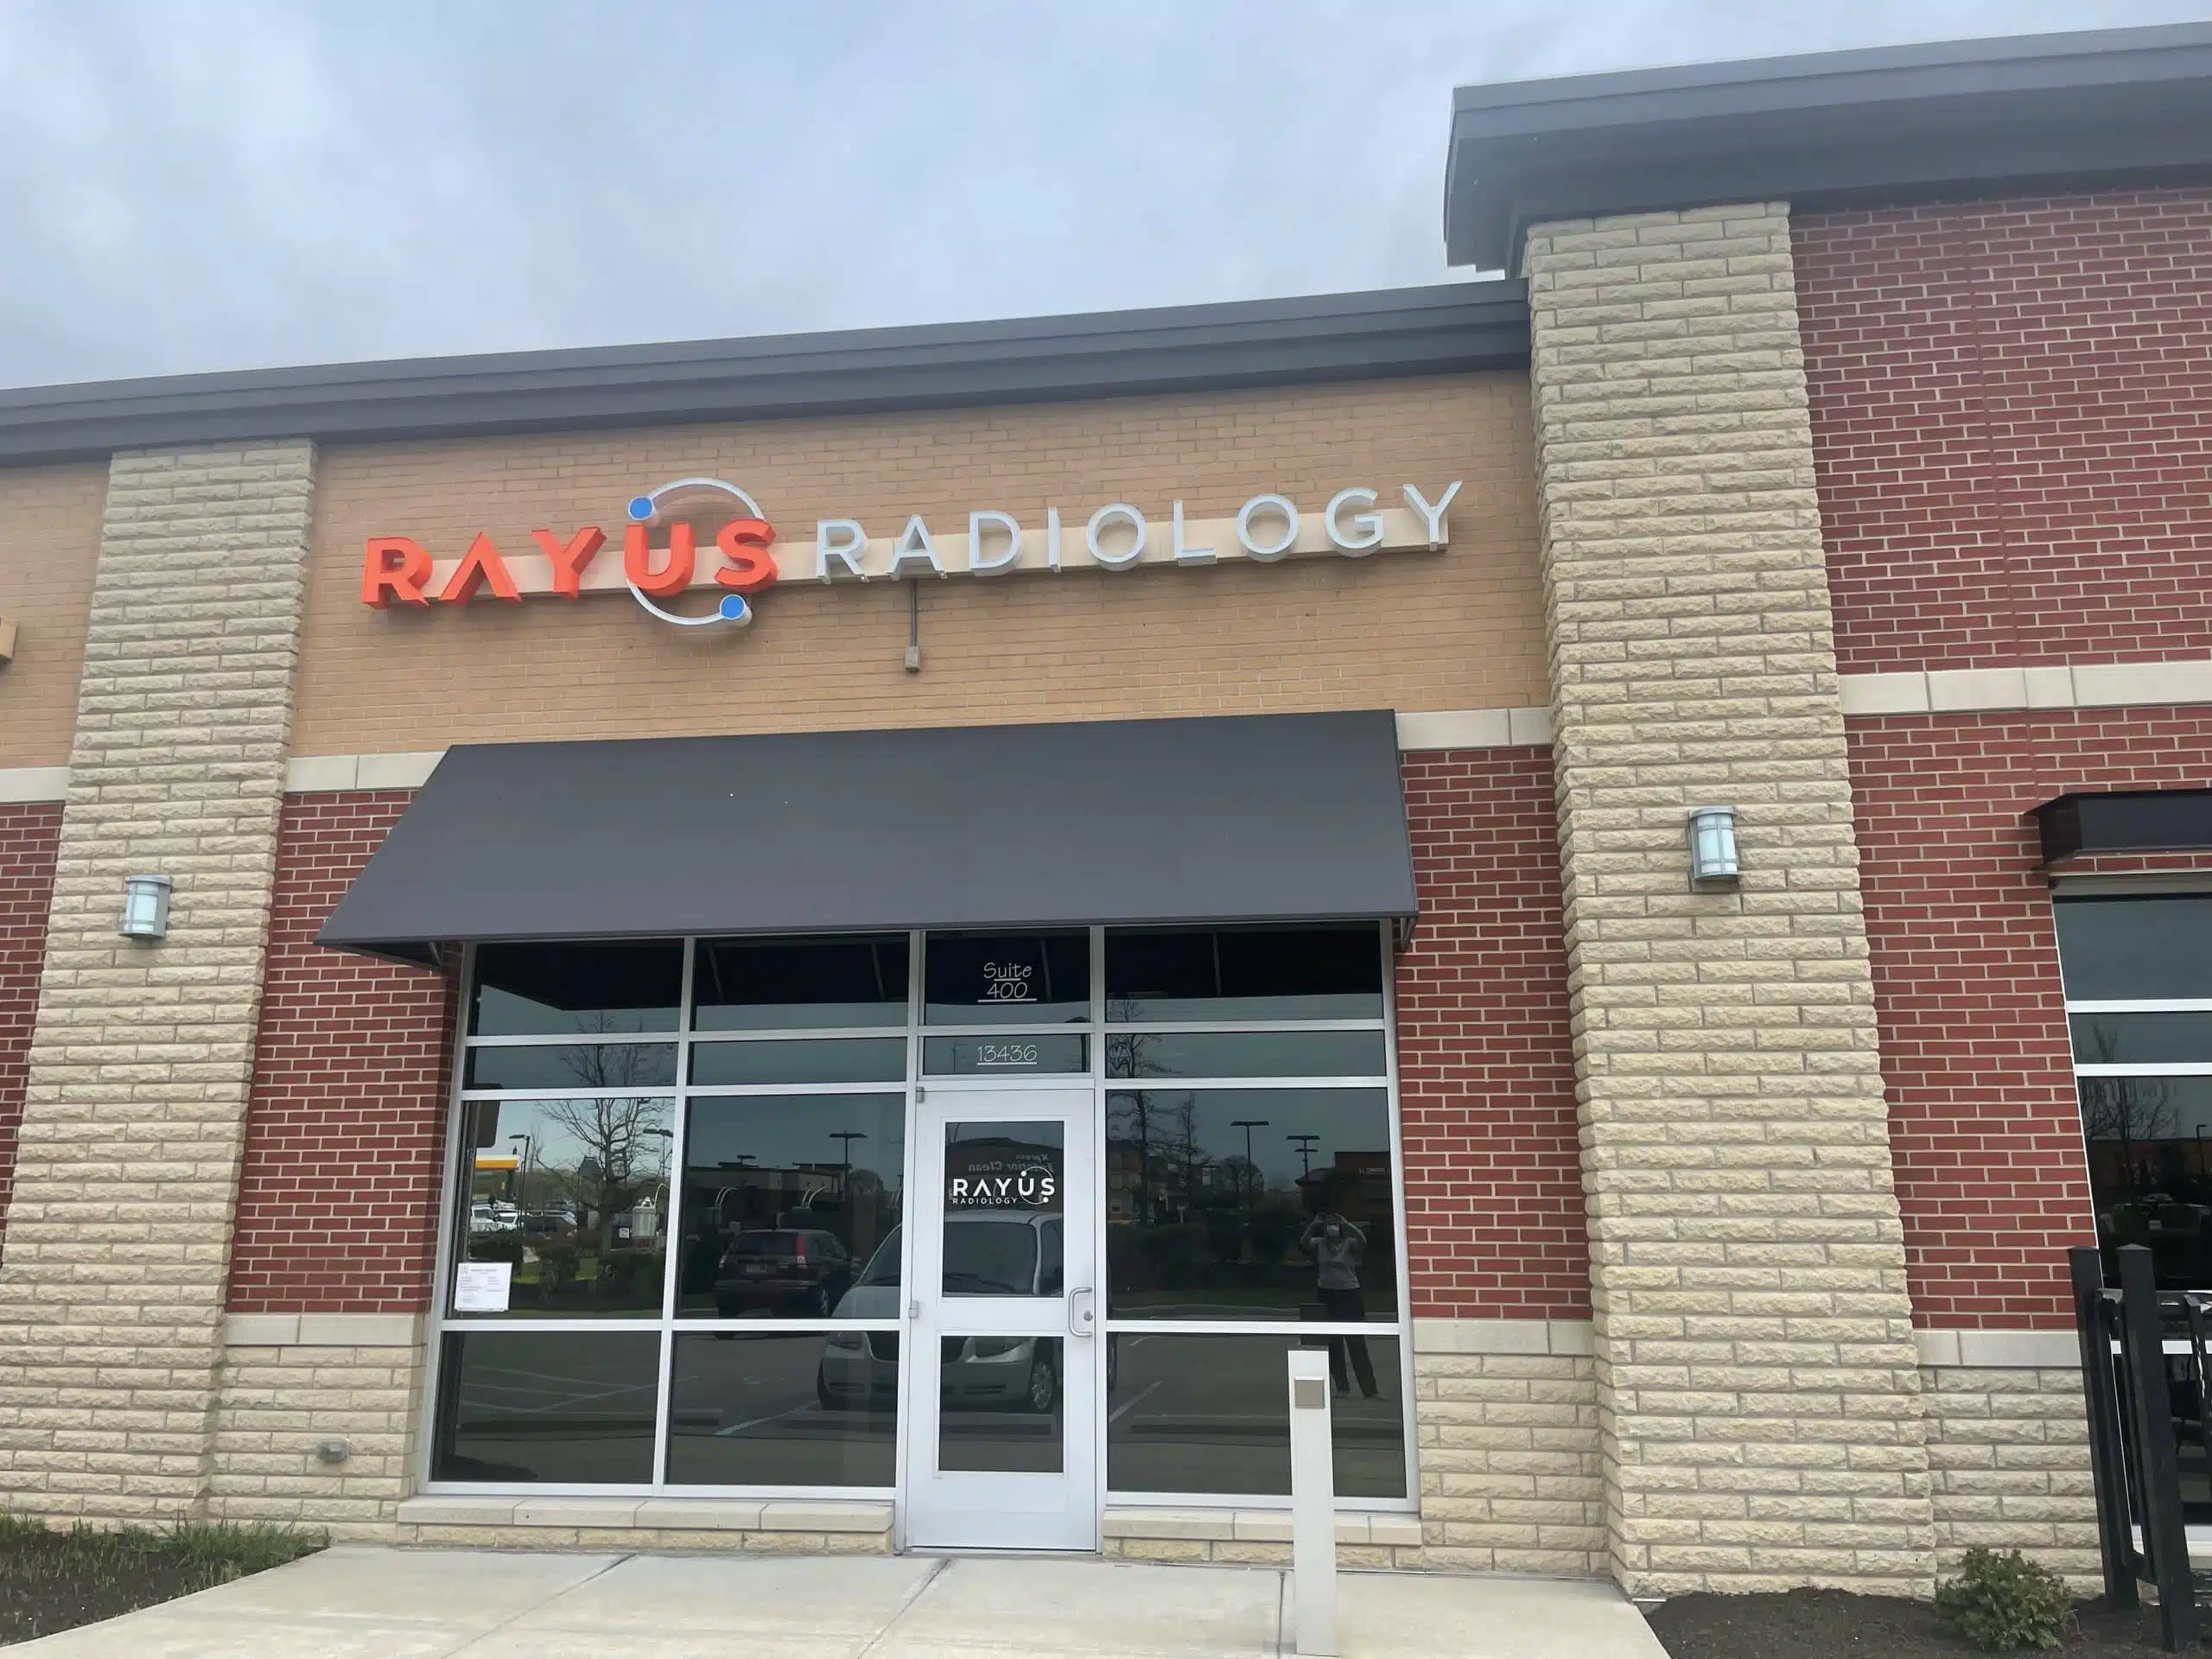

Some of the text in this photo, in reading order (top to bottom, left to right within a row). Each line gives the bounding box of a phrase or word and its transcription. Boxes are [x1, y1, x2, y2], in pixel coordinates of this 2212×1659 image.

[362, 480, 1463, 609] RAYUS RADIOLOGY
[983, 962, 1033, 979] Suite
[987, 982, 1028, 999] 400
[977, 1044, 1038, 1062] 13436
[952, 1178, 1055, 1197] RAYUS
